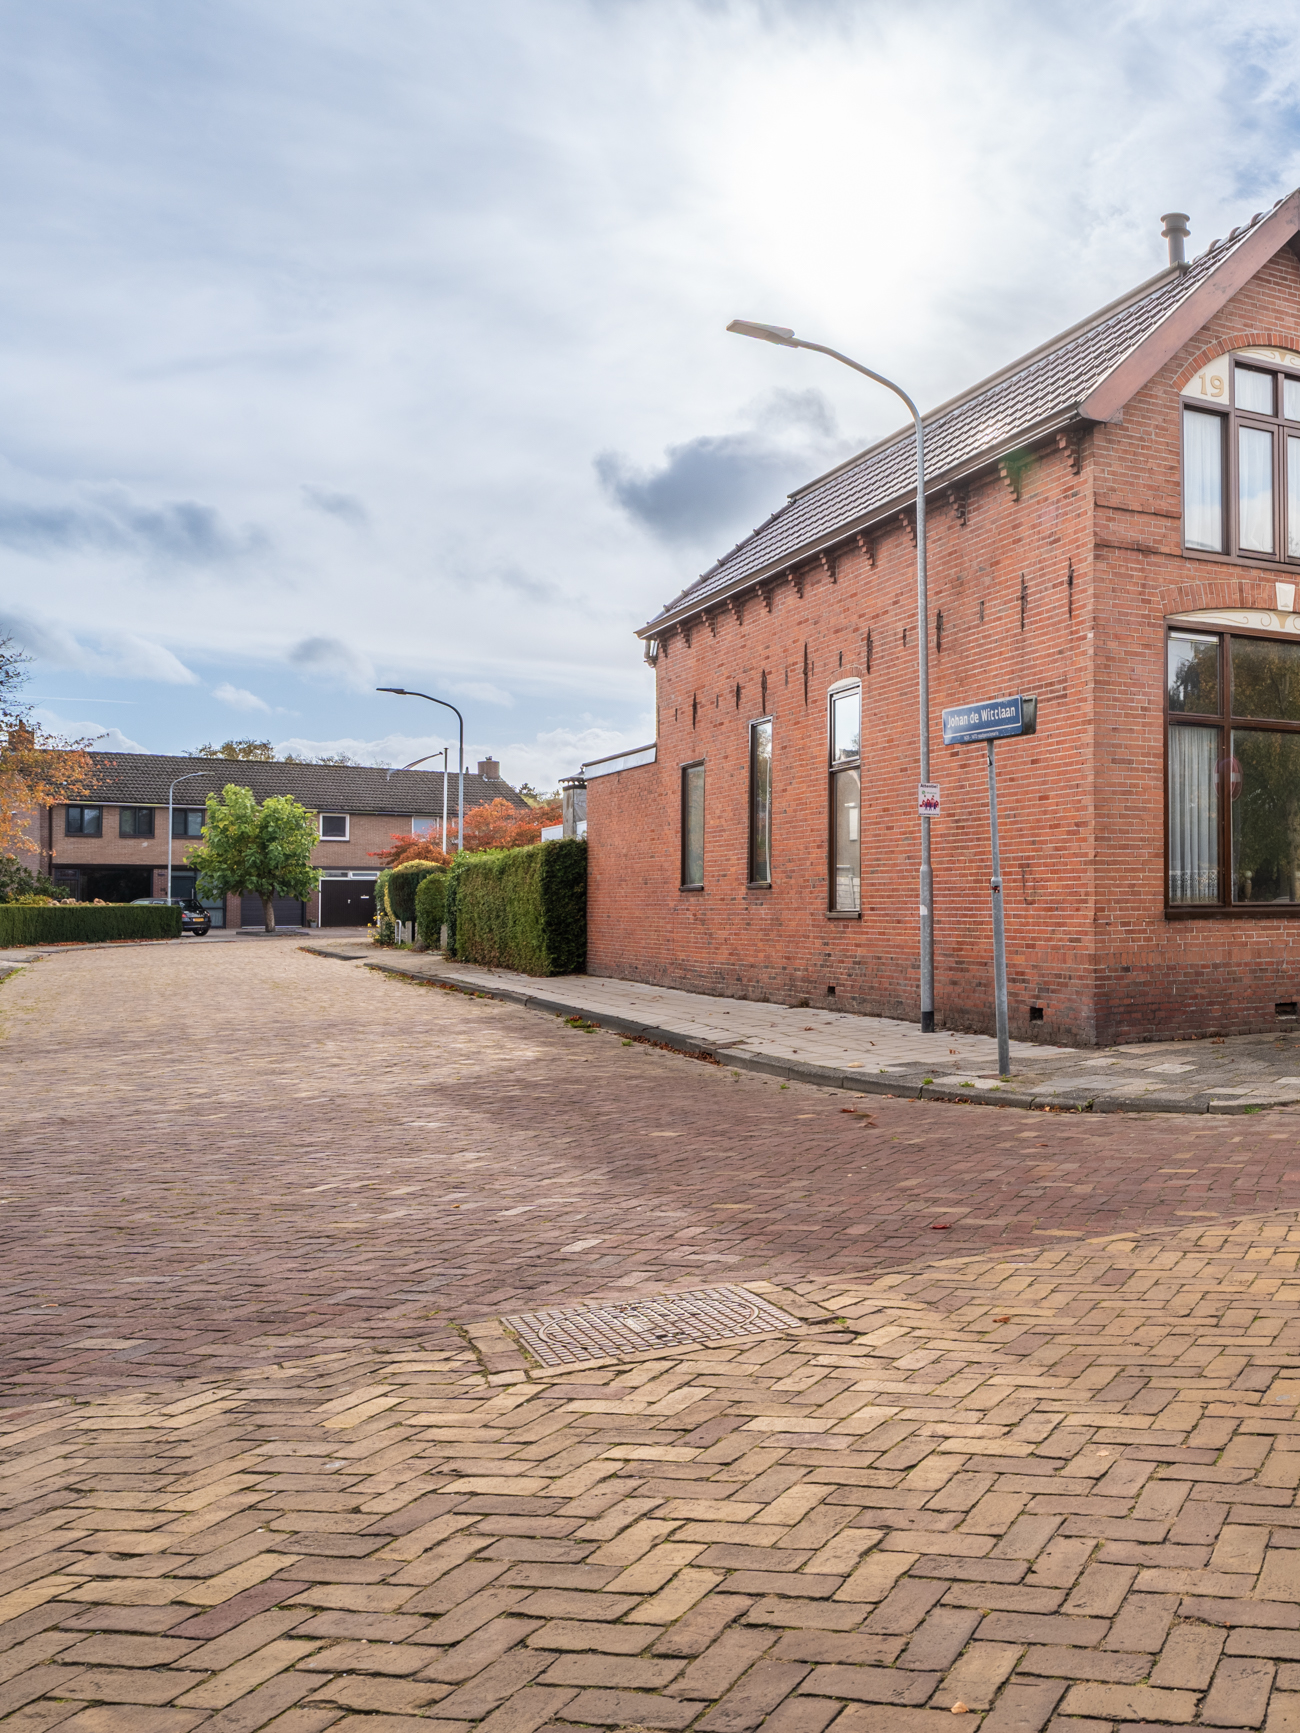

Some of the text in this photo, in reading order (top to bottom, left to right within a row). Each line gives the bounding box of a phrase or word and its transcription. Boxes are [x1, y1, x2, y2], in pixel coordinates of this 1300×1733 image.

[1198, 372, 1225, 398] 19
[947, 706, 1016, 728] Johan de Wittlaan
